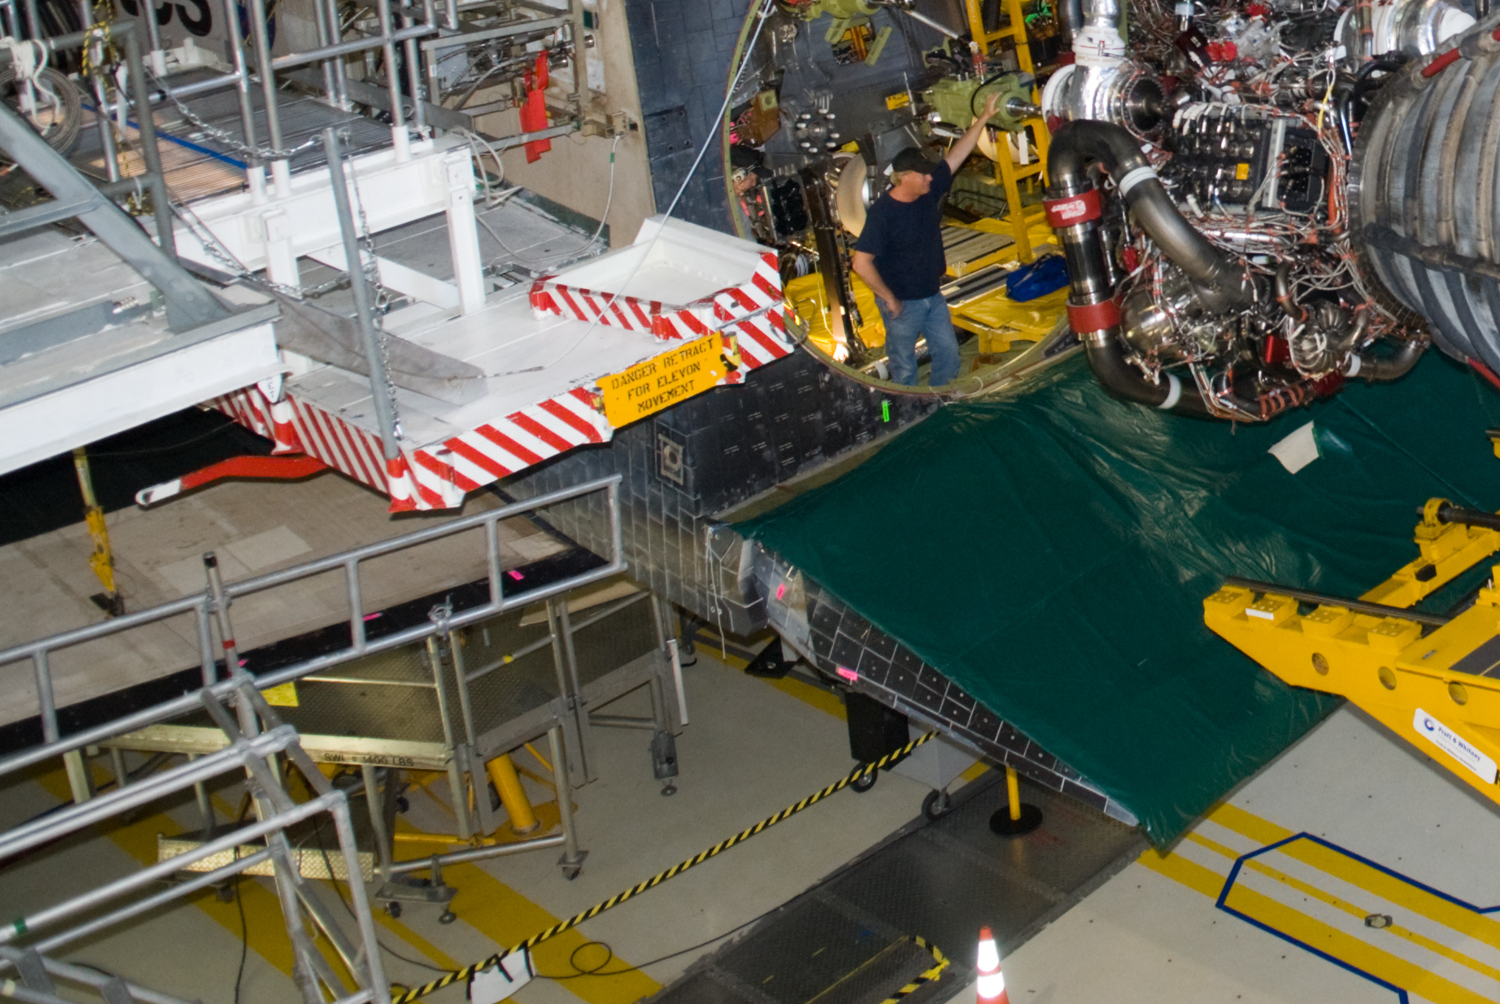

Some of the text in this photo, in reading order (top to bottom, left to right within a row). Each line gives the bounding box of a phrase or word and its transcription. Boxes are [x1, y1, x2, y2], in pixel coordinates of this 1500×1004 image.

[611, 362, 657, 390] DANGER
[663, 338, 713, 369] RETRACT
[627, 361, 701, 401] FOR ELEVON
[637, 380, 695, 413] MOVEMENT
[1438, 726, 1452, 740] Pratt
